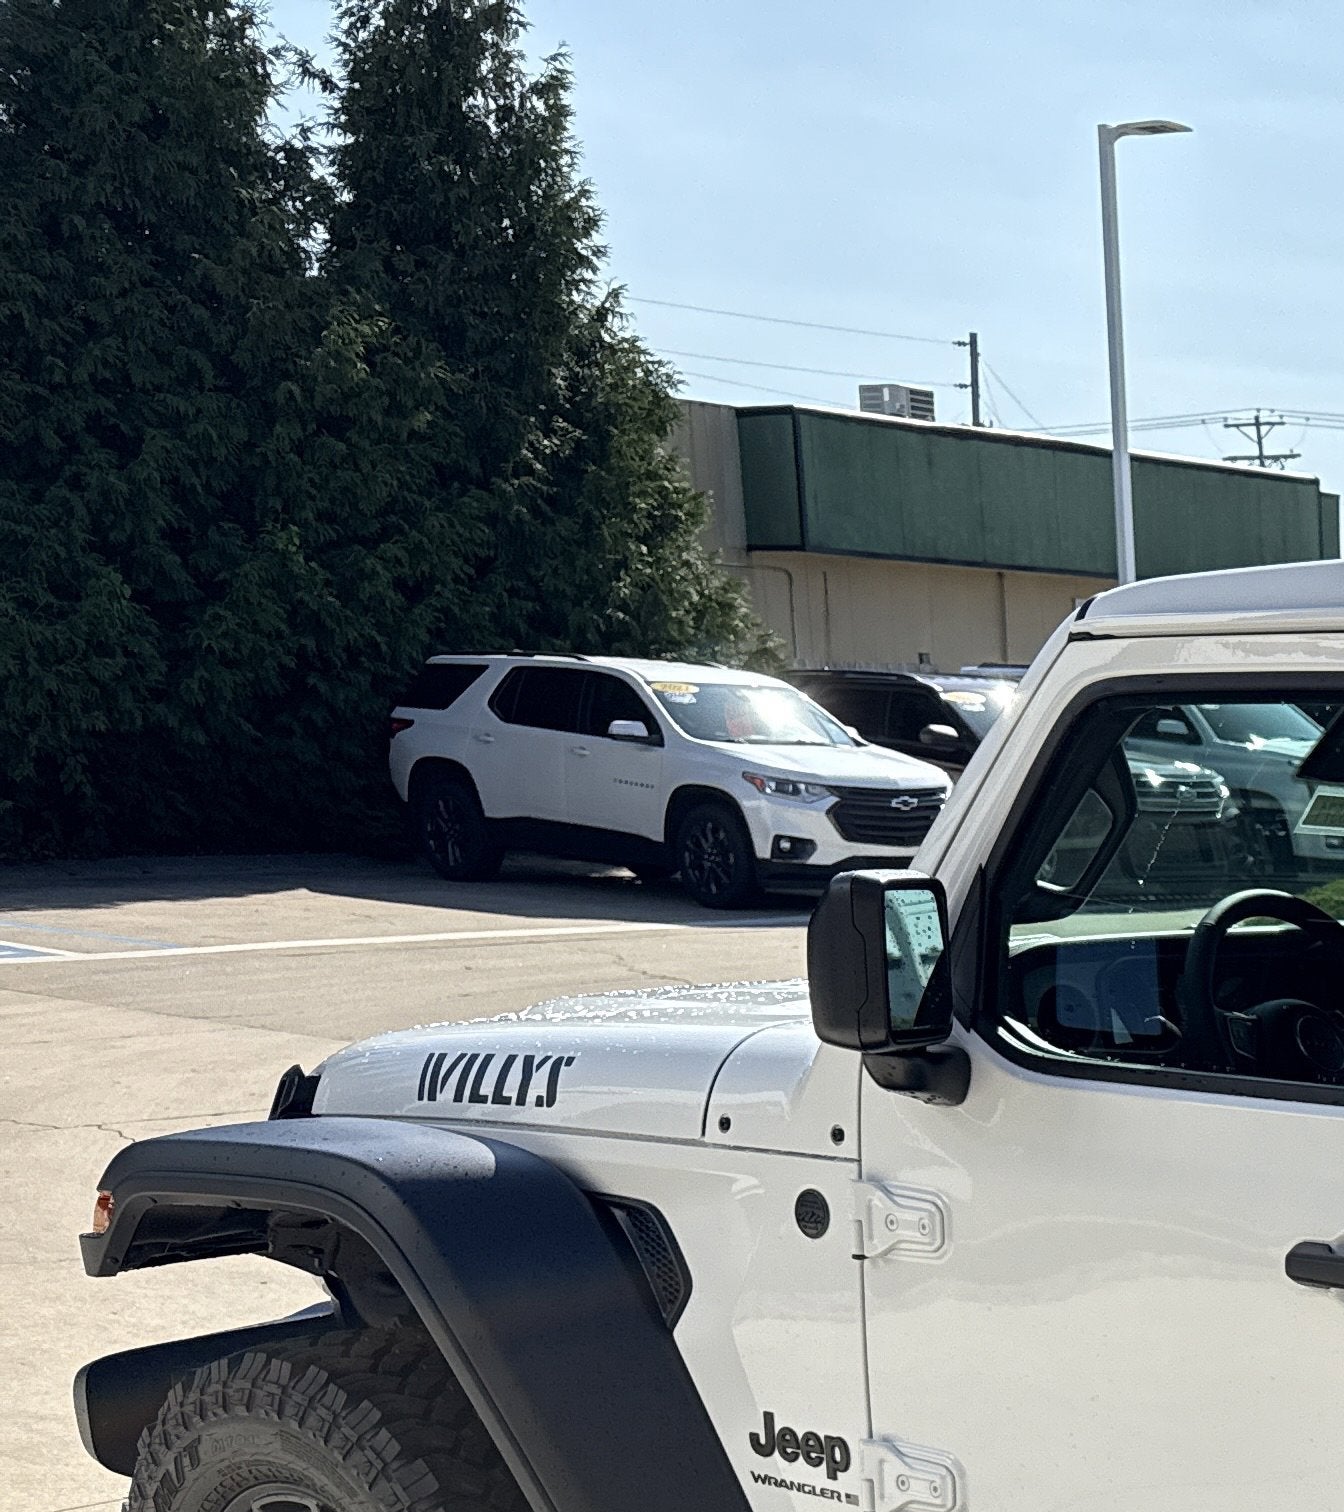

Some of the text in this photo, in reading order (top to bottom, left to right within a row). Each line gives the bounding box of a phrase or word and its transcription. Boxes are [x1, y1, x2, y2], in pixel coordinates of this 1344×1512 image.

[418, 1052, 576, 1108] WILLYS
[749, 1411, 850, 1480] Jeep
[750, 1471, 842, 1502] WRANGLER
